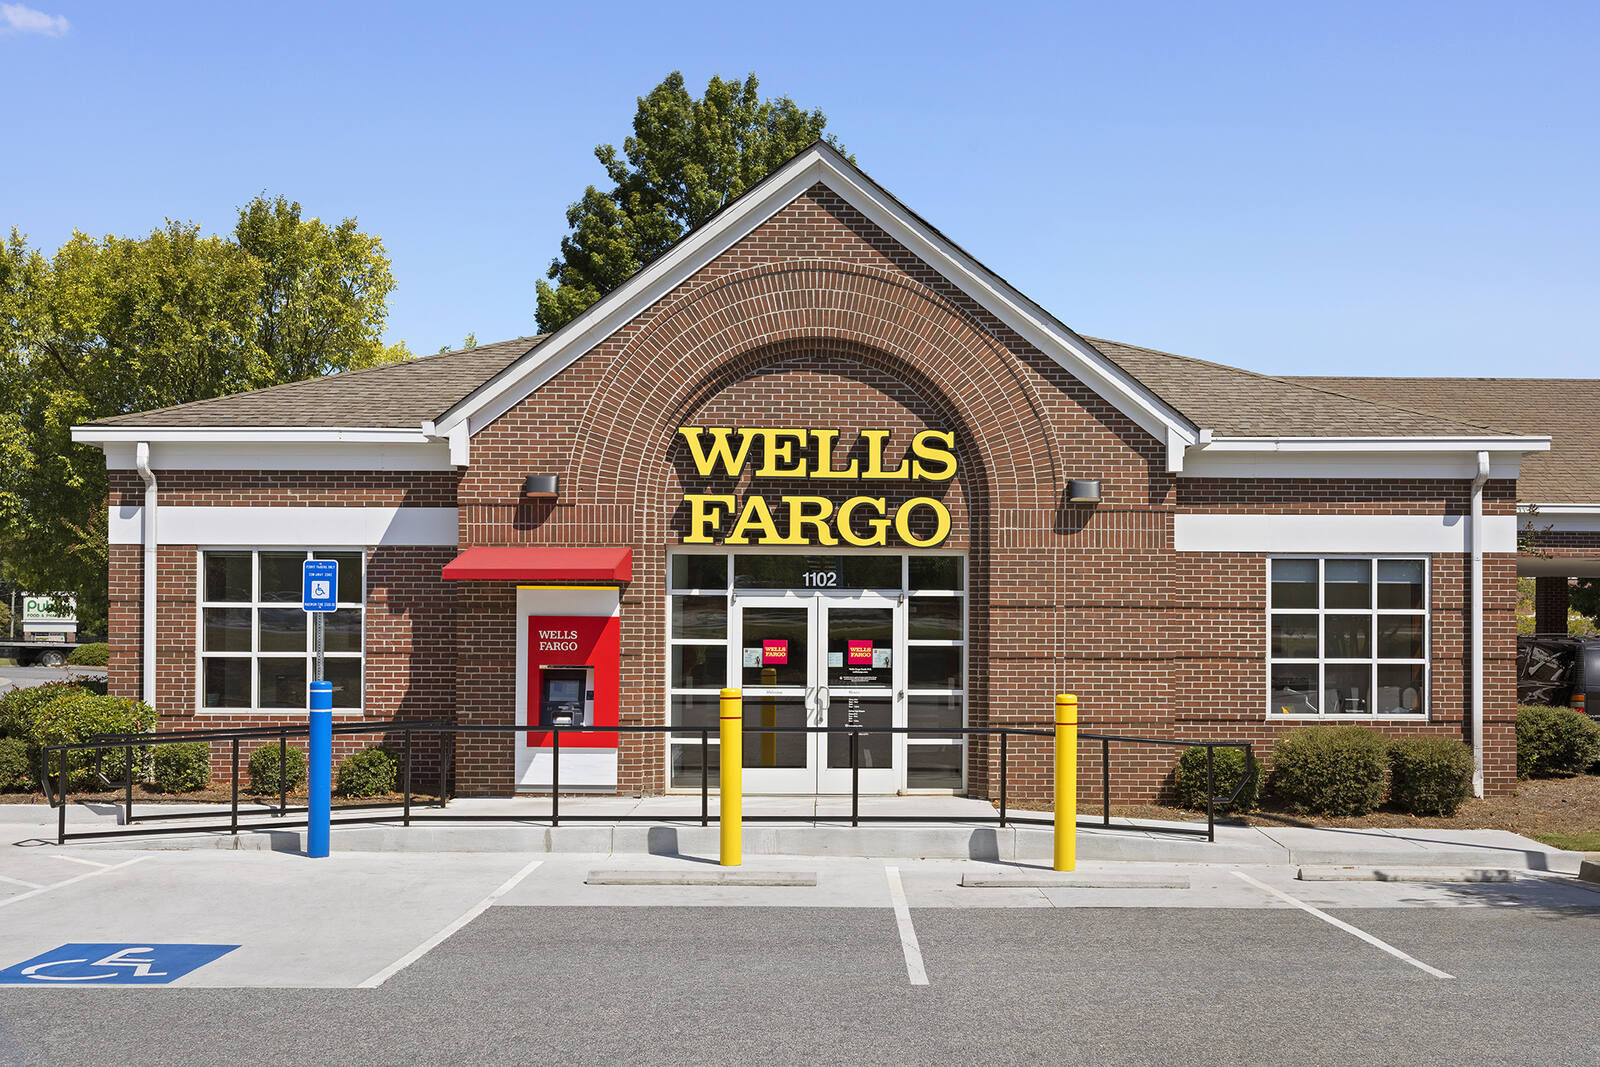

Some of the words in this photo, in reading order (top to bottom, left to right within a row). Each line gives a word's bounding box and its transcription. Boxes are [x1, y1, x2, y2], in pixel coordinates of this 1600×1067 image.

[678, 427, 958, 481] WELLS
[683, 494, 952, 547] FARGO
[802, 572, 837, 587] 1102
[538, 630, 578, 640] WELLS
[540, 642, 578, 651] FARGO
